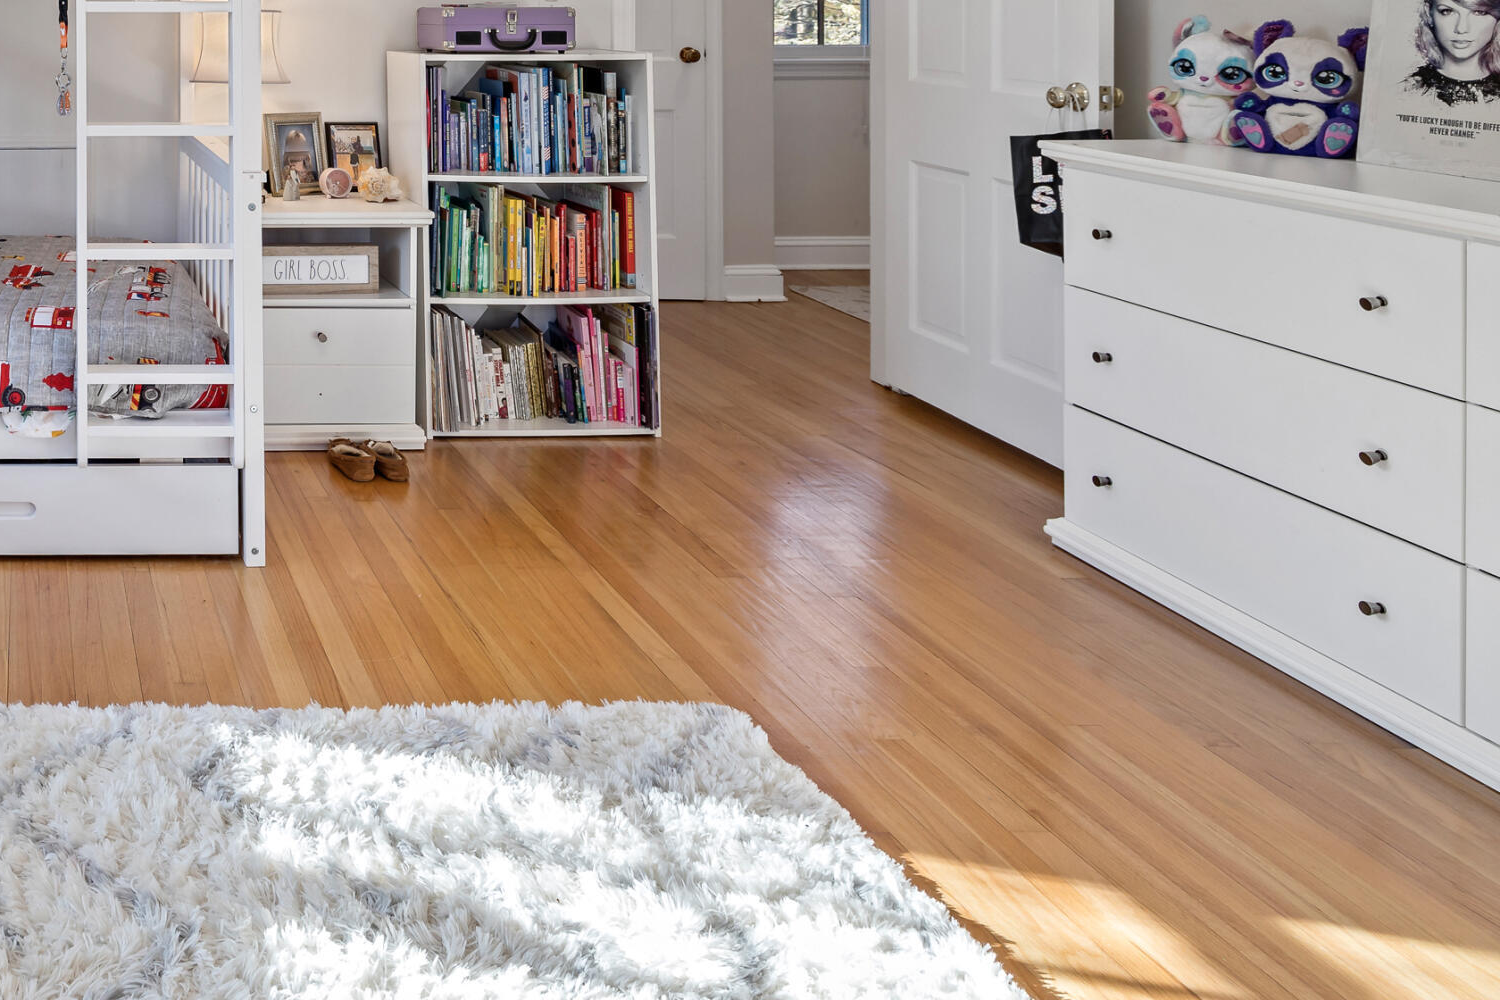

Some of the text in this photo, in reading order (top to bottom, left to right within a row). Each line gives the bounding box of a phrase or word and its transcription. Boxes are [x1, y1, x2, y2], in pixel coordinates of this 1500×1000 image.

[1419, 116, 1439, 125] LUCKY
[1440, 118, 1463, 128] ENOUGH
[1465, 121, 1473, 129] TO
[1473, 122, 1481, 130] BE
[1429, 127, 1449, 136] NEVER
[274, 259, 302, 281] GIRL
